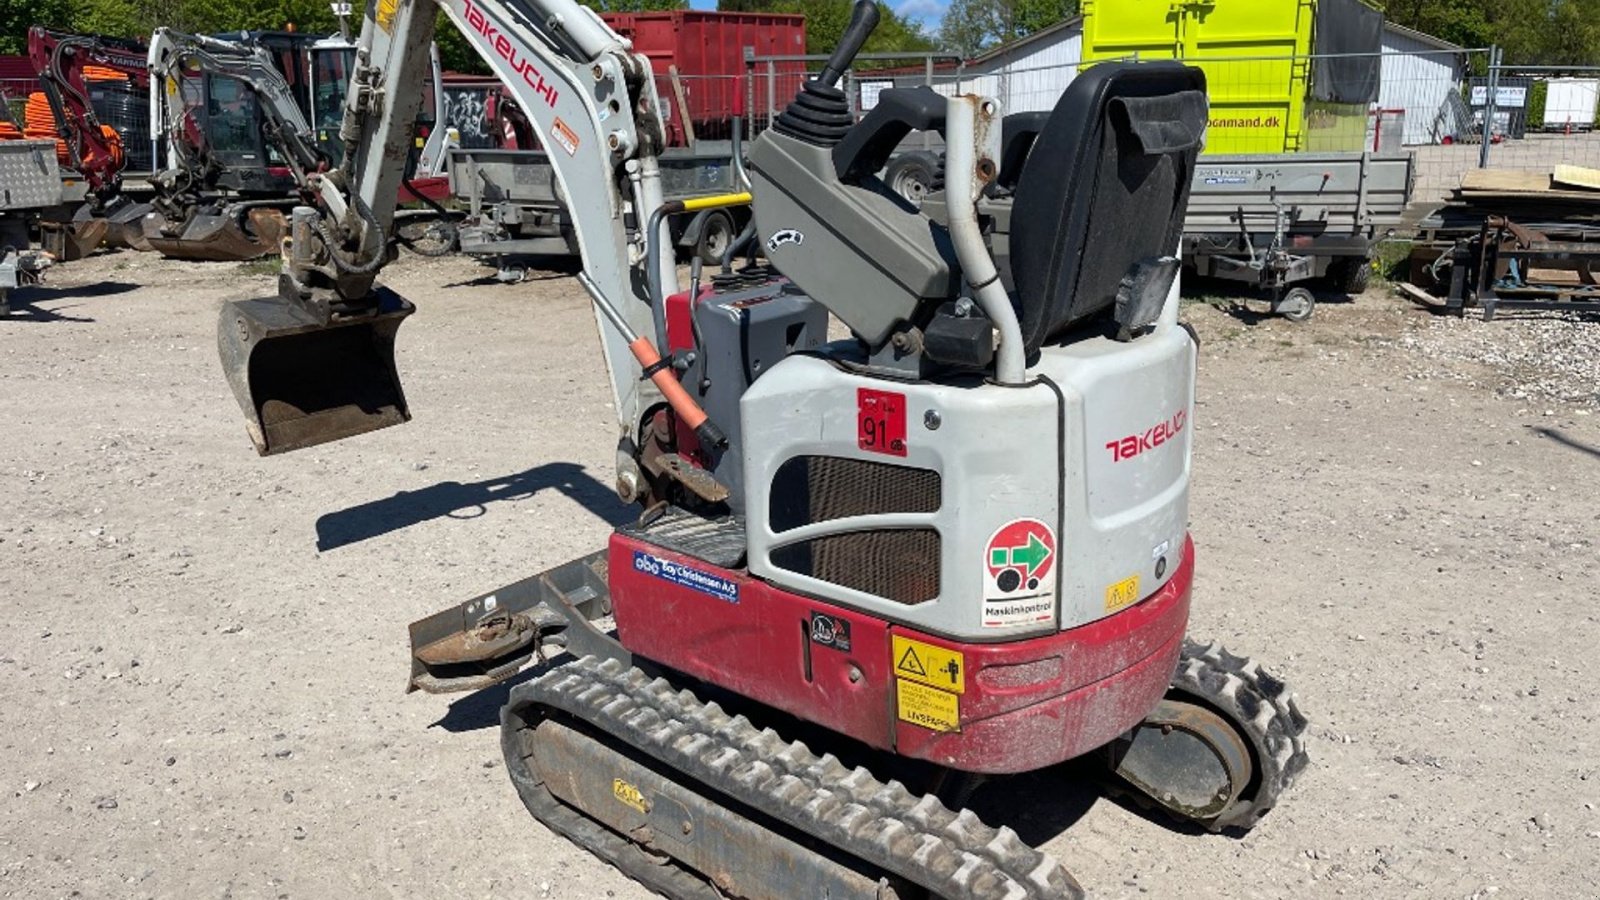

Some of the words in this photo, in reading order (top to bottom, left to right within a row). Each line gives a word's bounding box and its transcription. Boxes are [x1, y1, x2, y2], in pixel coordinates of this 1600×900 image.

[111, 56, 147, 69] YANMA
[863, 416, 886, 448] 91
[1106, 409, 1186, 462] TAKEUC
[985, 601, 1052, 616] Maskinkontrol
